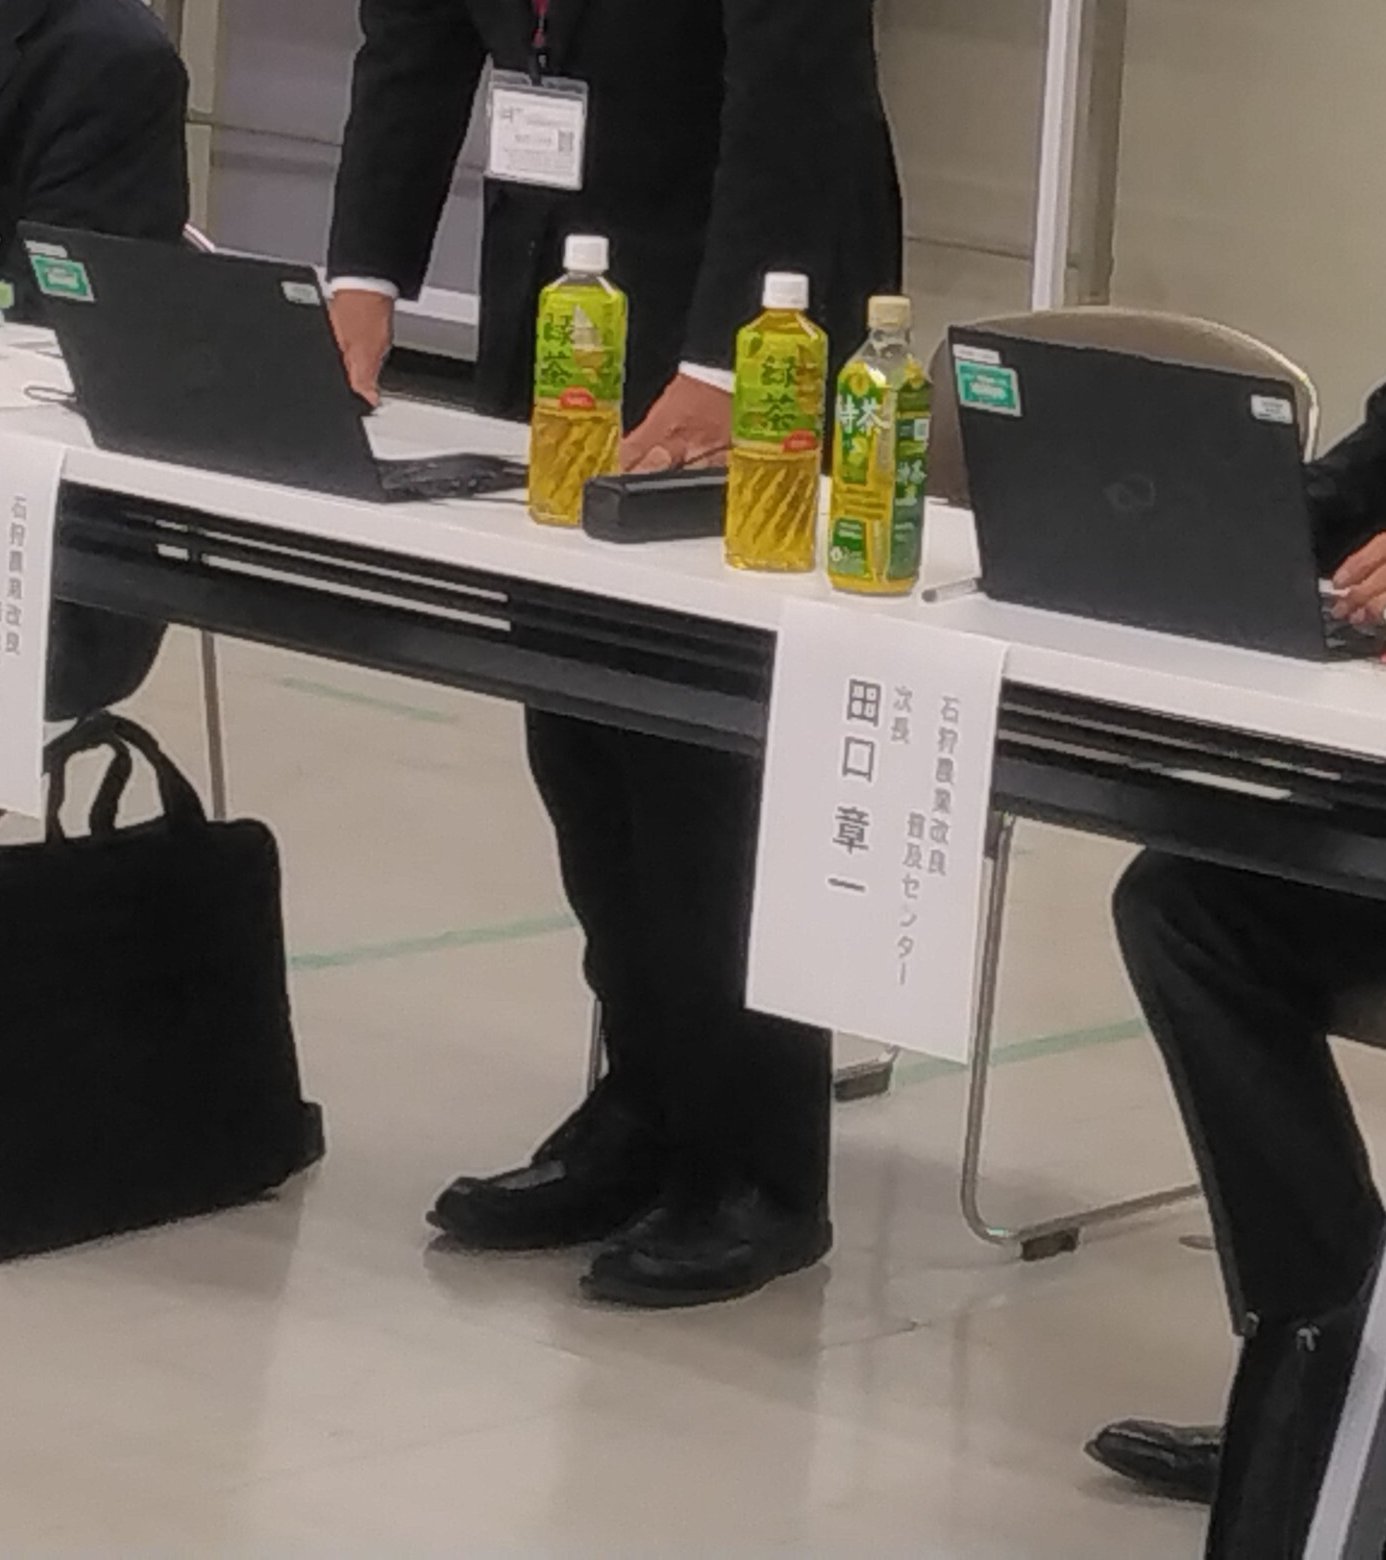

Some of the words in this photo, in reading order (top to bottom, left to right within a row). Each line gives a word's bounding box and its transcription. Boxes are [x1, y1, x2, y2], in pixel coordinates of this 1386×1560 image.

[841, 678, 882, 784] 田口
[889, 685, 914, 746] 次長
[827, 805, 871, 894] 章一
